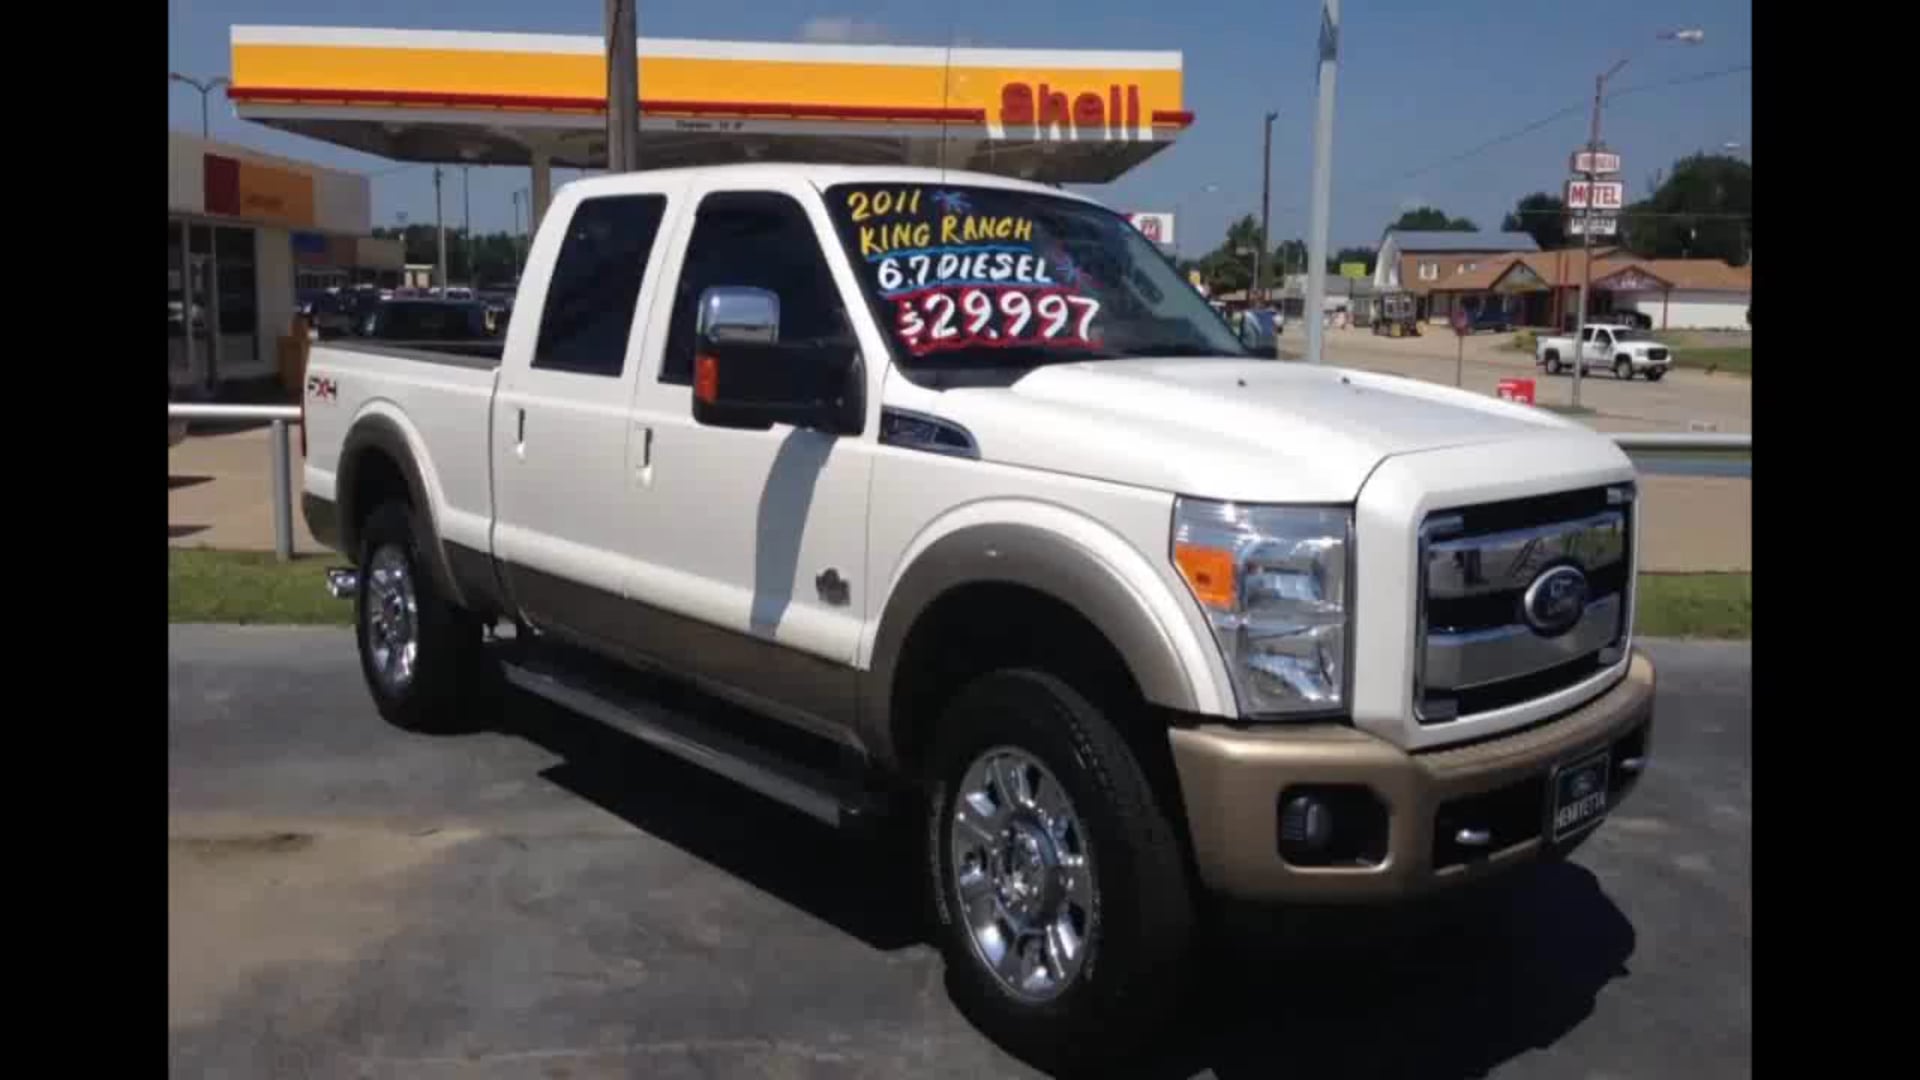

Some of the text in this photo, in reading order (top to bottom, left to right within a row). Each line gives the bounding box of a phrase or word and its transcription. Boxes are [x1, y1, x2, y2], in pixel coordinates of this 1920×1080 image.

[1000, 82, 1139, 139] Shell
[847, 189, 920, 222] 2011
[860, 214, 1032, 255] KING RANCH
